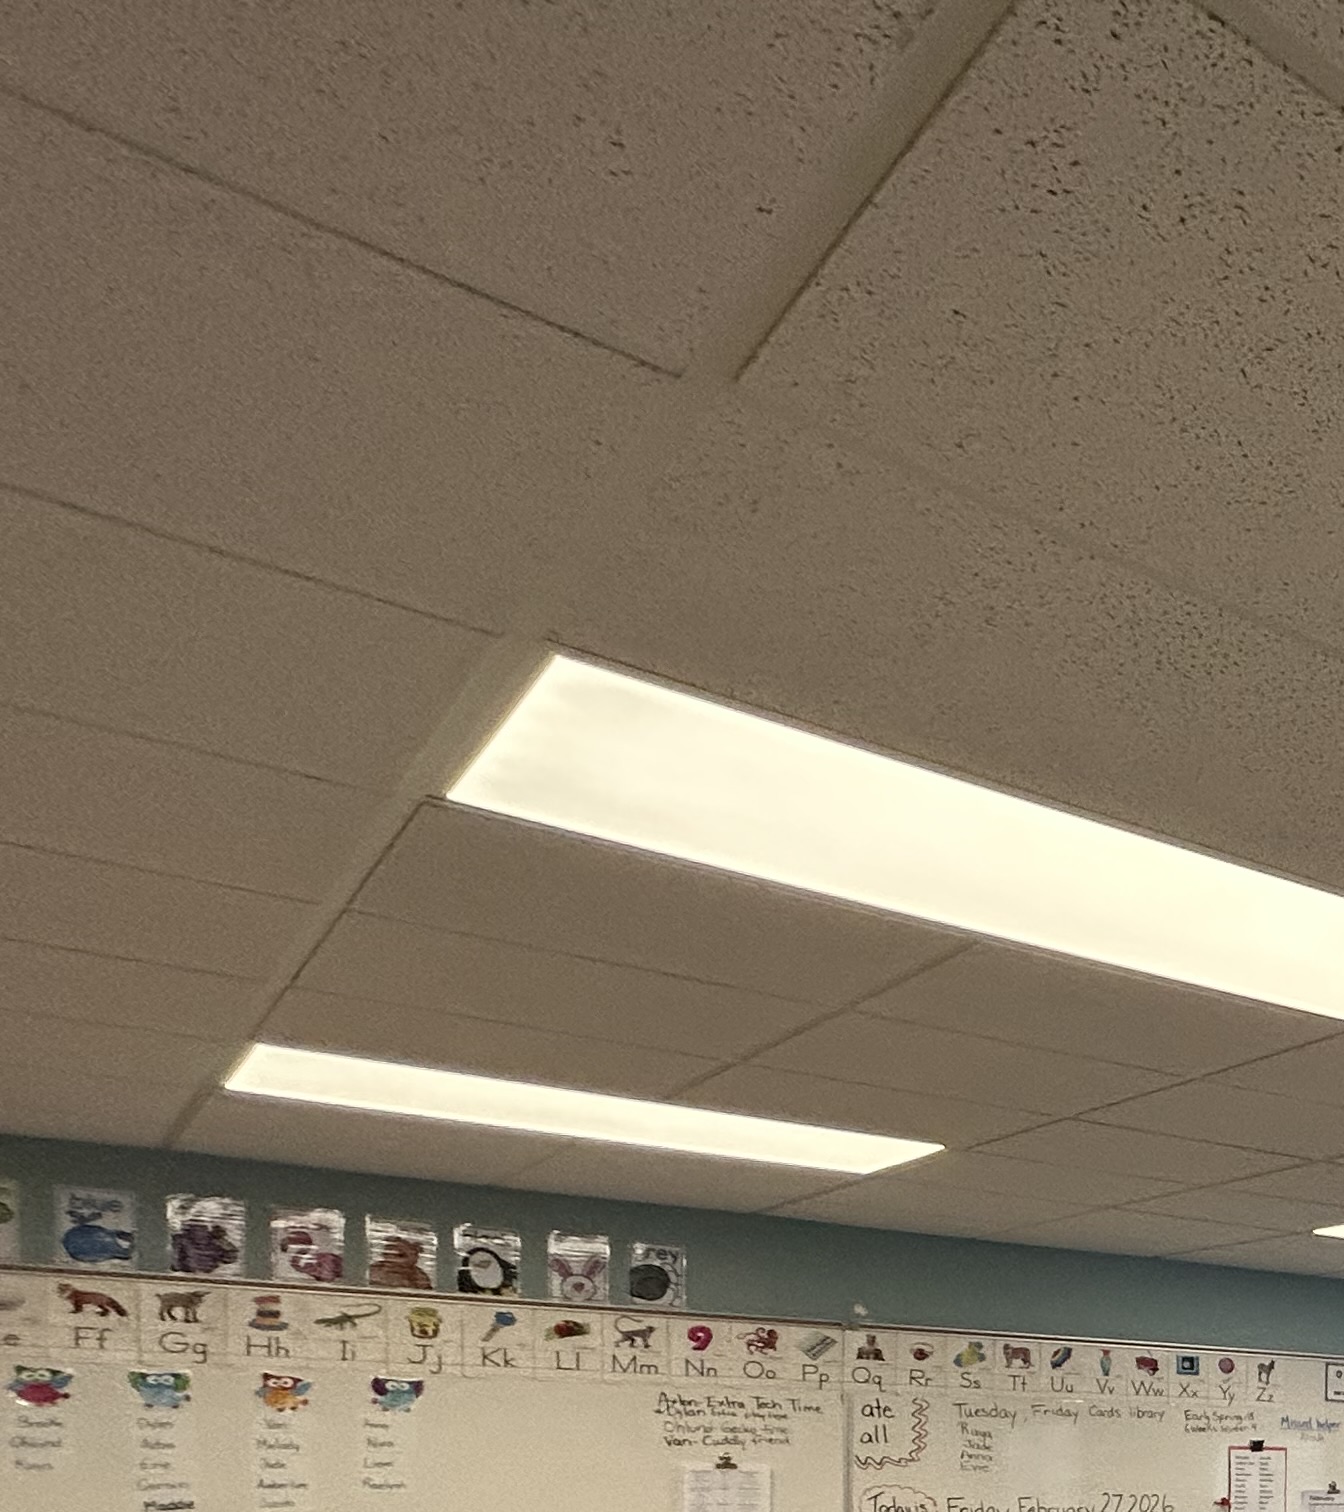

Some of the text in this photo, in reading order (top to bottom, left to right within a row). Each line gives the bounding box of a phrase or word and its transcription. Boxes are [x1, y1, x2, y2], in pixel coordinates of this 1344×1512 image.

[74, 1327, 113, 1350] Ff
[158, 1331, 208, 1364] Gg
[246, 1335, 290, 1357] Hh
[407, 1344, 442, 1374] Jj
[481, 1348, 515, 1368] Kk
[612, 1353, 659, 1374] Mm
[685, 1358, 717, 1377] Nn
[743, 1360, 776, 1380] Oo
[802, 1364, 830, 1389] Pp
[851, 1366, 886, 1392] Qq
[909, 1369, 933, 1387] Rr
[959, 1372, 982, 1389] Ss
[1010, 1375, 1028, 1391] Tt
[1050, 1379, 1074, 1394] Uu
[1096, 1379, 1115, 1394] Vv
[1131, 1380, 1165, 1396] Ww
[1178, 1382, 1200, 1398] Xx
[703, 1395, 824, 1414] Extra Tech Time
[1218, 1385, 1236, 1406] Yy
[1256, 1387, 1276, 1402] Zz
[861, 1398, 896, 1419] ate
[1031, 1403, 1080, 1425] Friday
[1088, 1404, 1122, 1418] Cards
[860, 1424, 888, 1444] all
